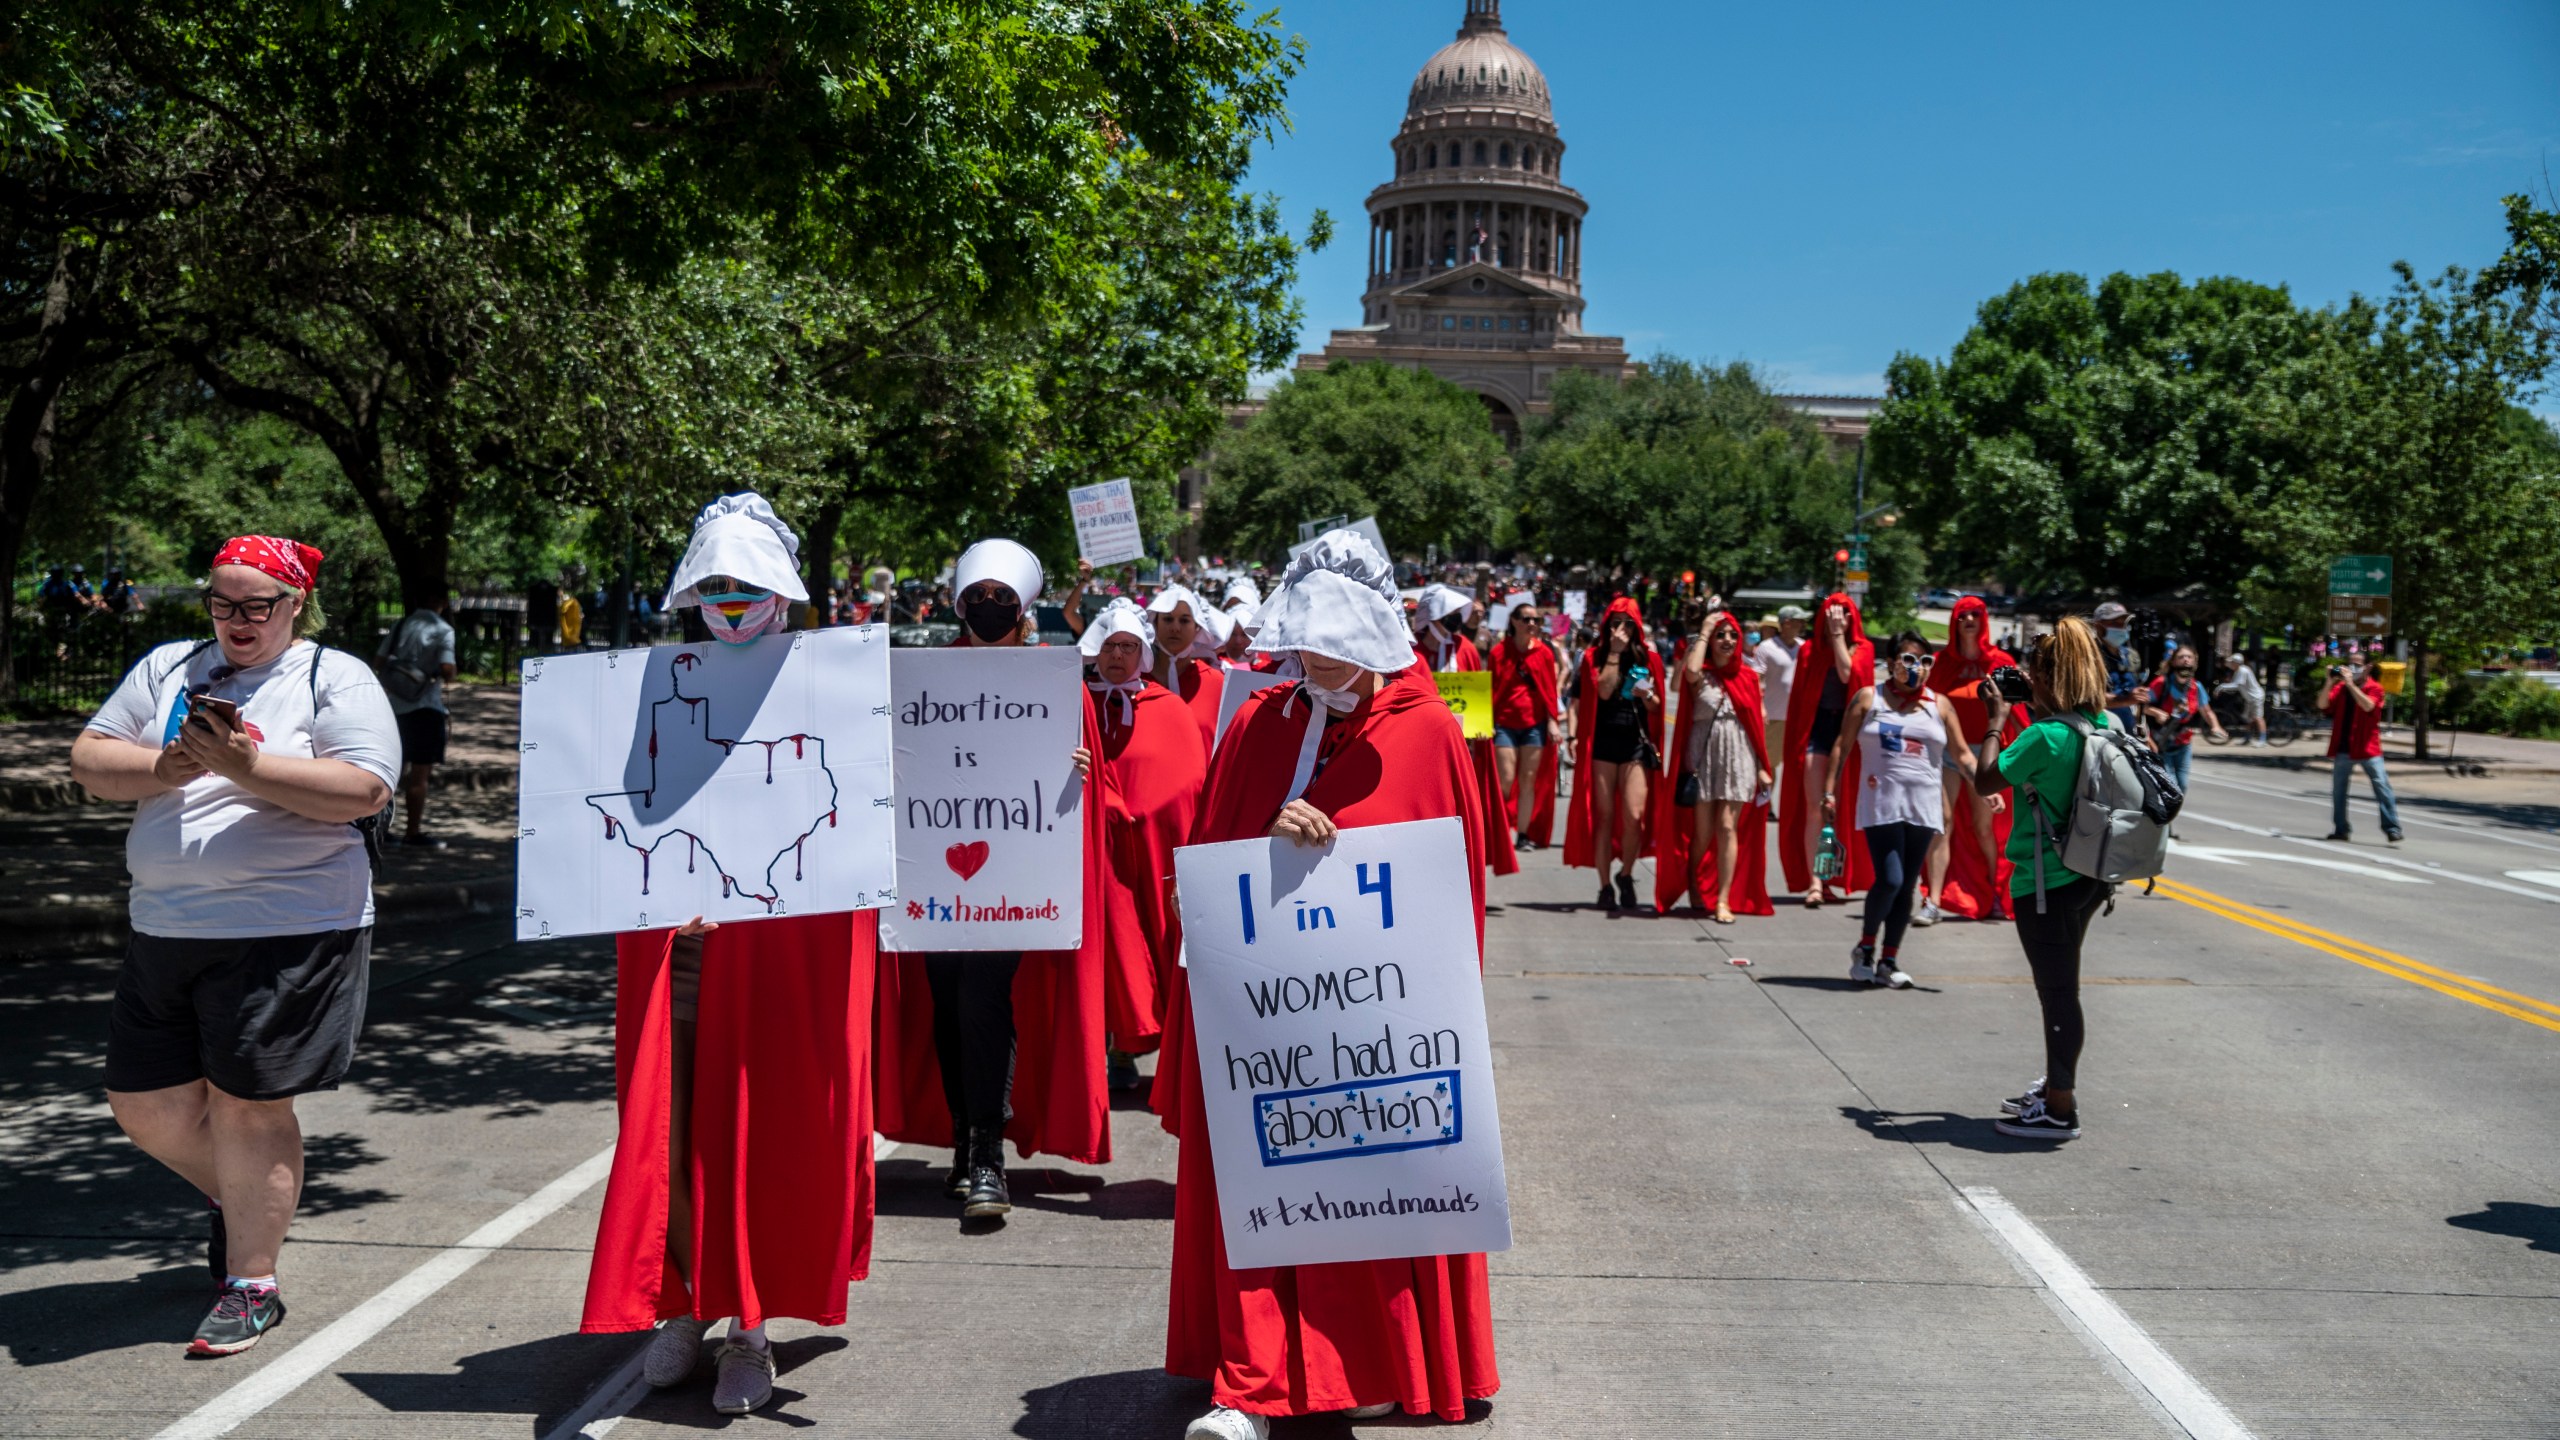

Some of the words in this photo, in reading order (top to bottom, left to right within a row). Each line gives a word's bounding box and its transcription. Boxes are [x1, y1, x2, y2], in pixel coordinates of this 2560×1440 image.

[1071, 487, 1100, 504] THINGS
[1104, 481, 1127, 498] THAT
[1076, 499, 1106, 516] REDUCE
[1112, 496, 1129, 510] THE
[1078, 519, 1088, 530] #
[1090, 517, 1098, 528] OF
[1100, 510, 1134, 526] ABORTIONS
[901, 691, 1048, 726] abortion
[954, 746, 977, 768] is
[908, 780, 1052, 833] normal.
[907, 895, 1059, 922] #txhandmaids
[1239, 873, 1256, 945] 1
[1294, 901, 1337, 931] in
[1356, 862, 1394, 930] 4
[1225, 1044, 1320, 1091] have
[1332, 1024, 1396, 1080] had
[1408, 1029, 1460, 1069] an
[1267, 1091, 1440, 1147] abortion
[1244, 1184, 1480, 1233] #txhandmaids
